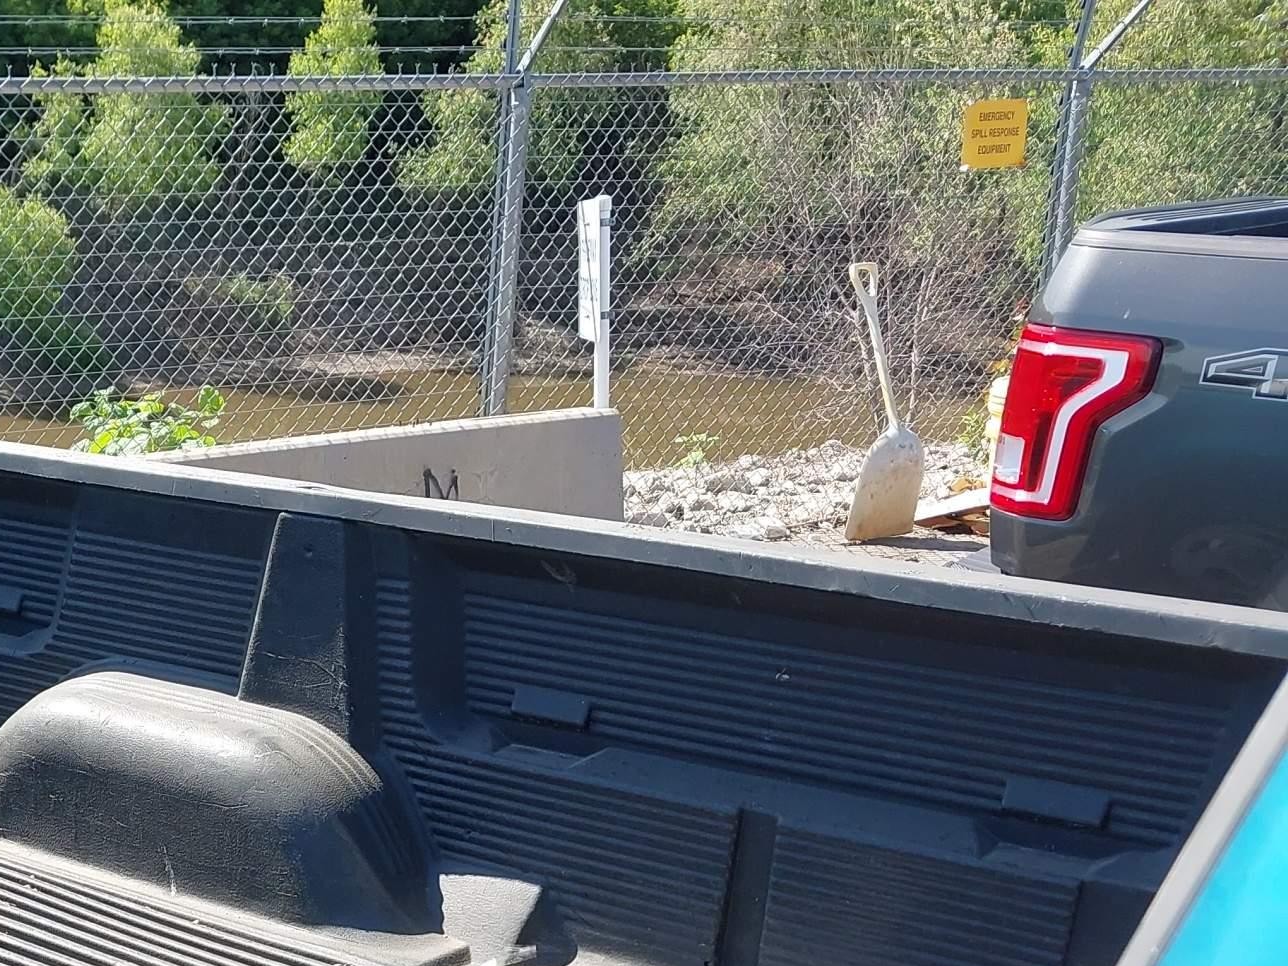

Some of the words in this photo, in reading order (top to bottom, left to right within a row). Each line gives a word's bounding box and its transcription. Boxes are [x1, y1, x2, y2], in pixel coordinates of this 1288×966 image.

[979, 111, 1015, 121] EMERGENCY
[971, 129, 987, 138] SPILL
[989, 127, 1020, 137] RESPONSE
[977, 144, 1011, 154] EQUIPMENT
